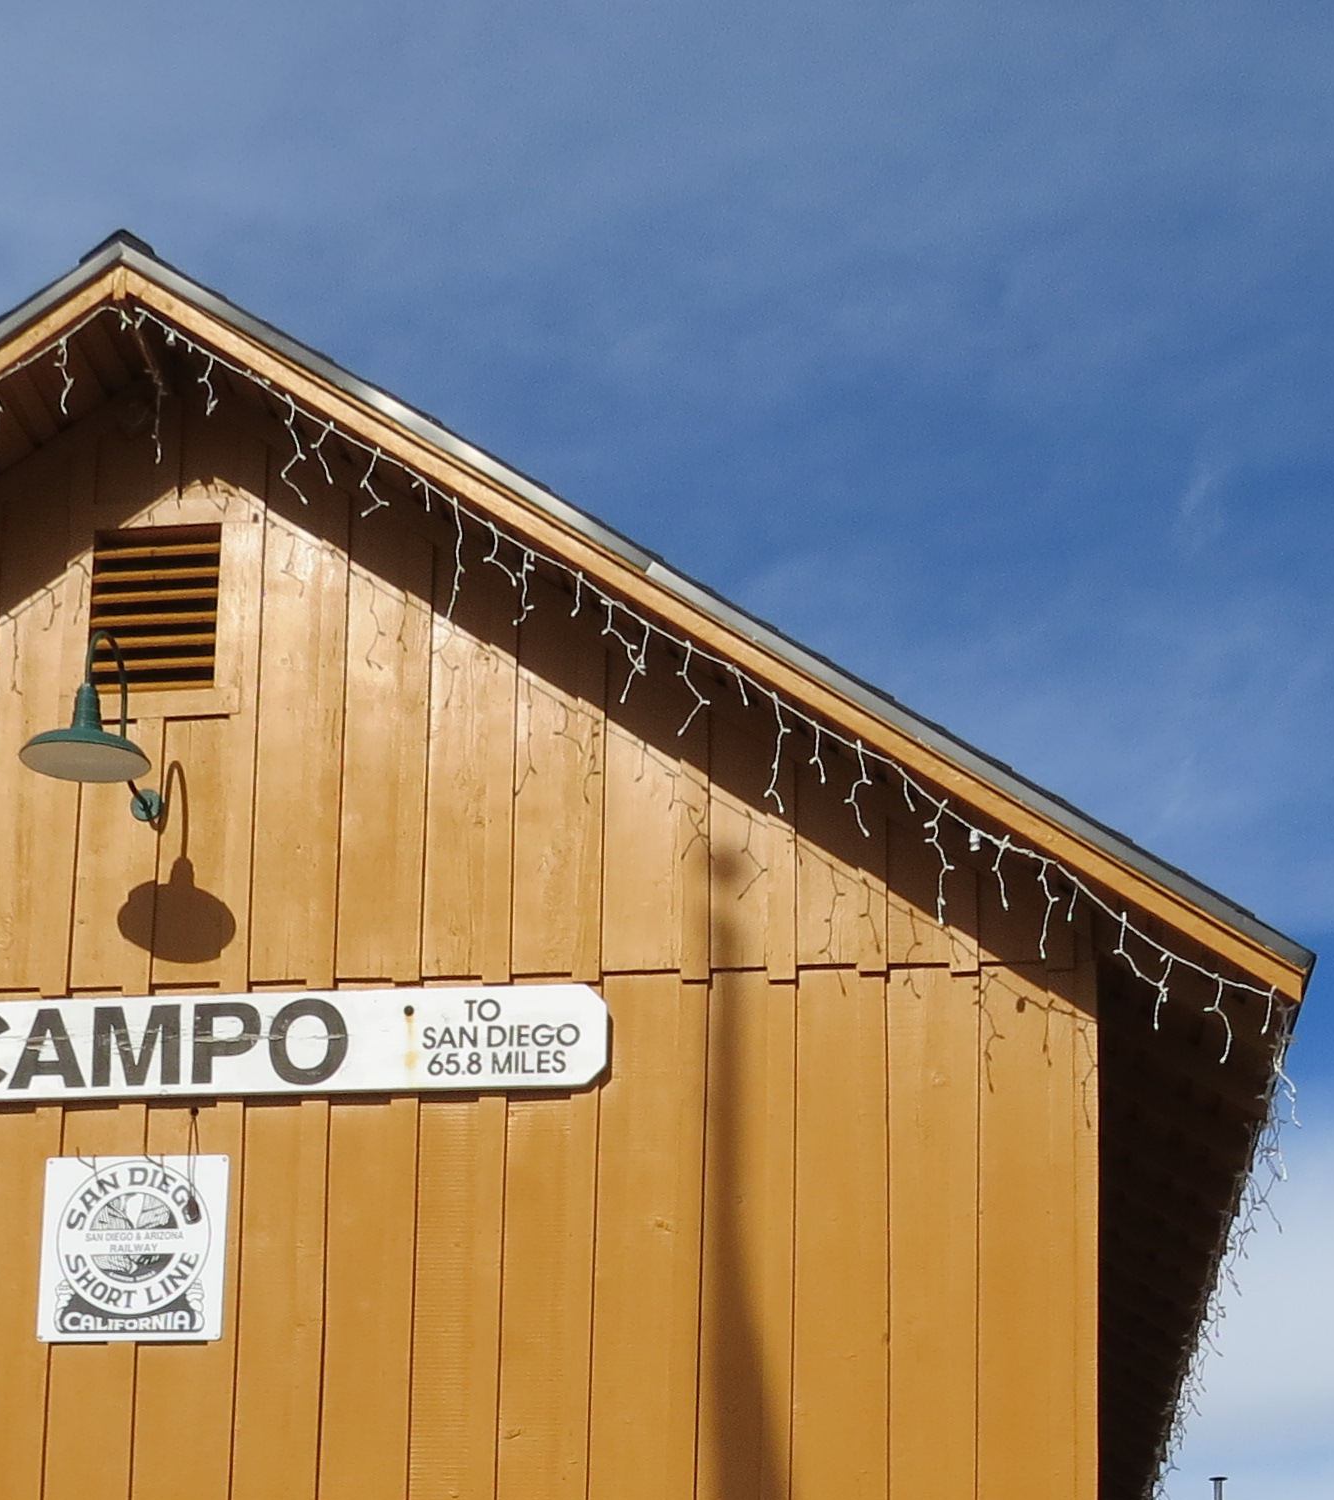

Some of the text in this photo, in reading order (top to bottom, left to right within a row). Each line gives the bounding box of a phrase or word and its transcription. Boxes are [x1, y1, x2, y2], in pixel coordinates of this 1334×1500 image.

[464, 999, 501, 1022] TO
[422, 1023, 580, 1050] SAN DIEGO
[427, 1050, 567, 1076] 65.8 MILES
[66, 1173, 122, 1231] SAN
[85, 1233, 104, 1242] SAN
[105, 1232, 133, 1242] DIEGO
[144, 1230, 185, 1241] ARIZONA
[109, 1243, 158, 1253] RAILWAY
[65, 1252, 200, 1309] SHORT LINE
[63, 1310, 192, 1332] CALIFORNIA
